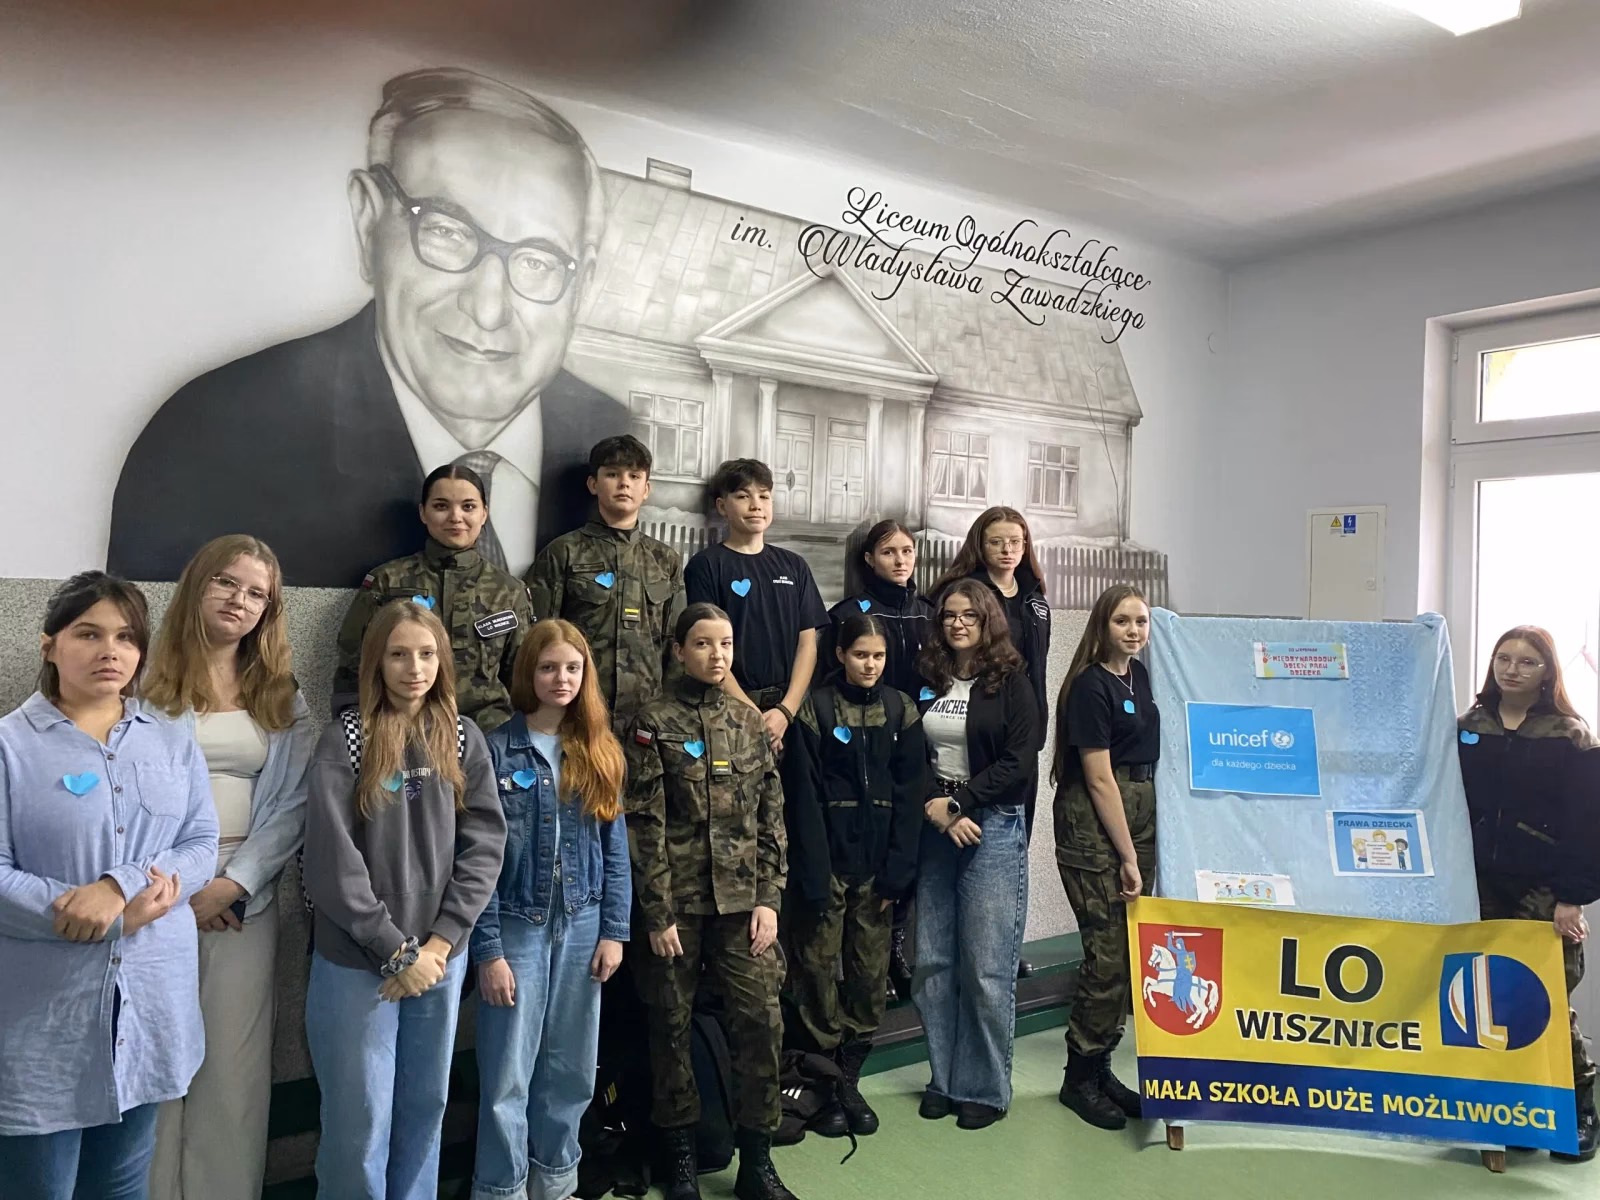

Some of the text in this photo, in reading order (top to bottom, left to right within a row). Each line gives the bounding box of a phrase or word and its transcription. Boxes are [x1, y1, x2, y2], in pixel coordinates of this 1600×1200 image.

[841, 186, 1151, 292] Liceum Ogólnokształcące
[730, 216, 1146, 344] im. Władysława Zawadzkiego
[928, 700, 968, 714] ANCHE
[1209, 728, 1269, 748] unicef
[1211, 758, 1297, 771] dla każdego dziecka
[1337, 819, 1413, 829] PRAWA DZIECKA
[1280, 936, 1385, 1004] LO
[1235, 1008, 1423, 1052] WISZNICE
[1144, 1078, 1557, 1131] MAŁA SZKOŁA DUŻE MOŻLIWOŚCI
